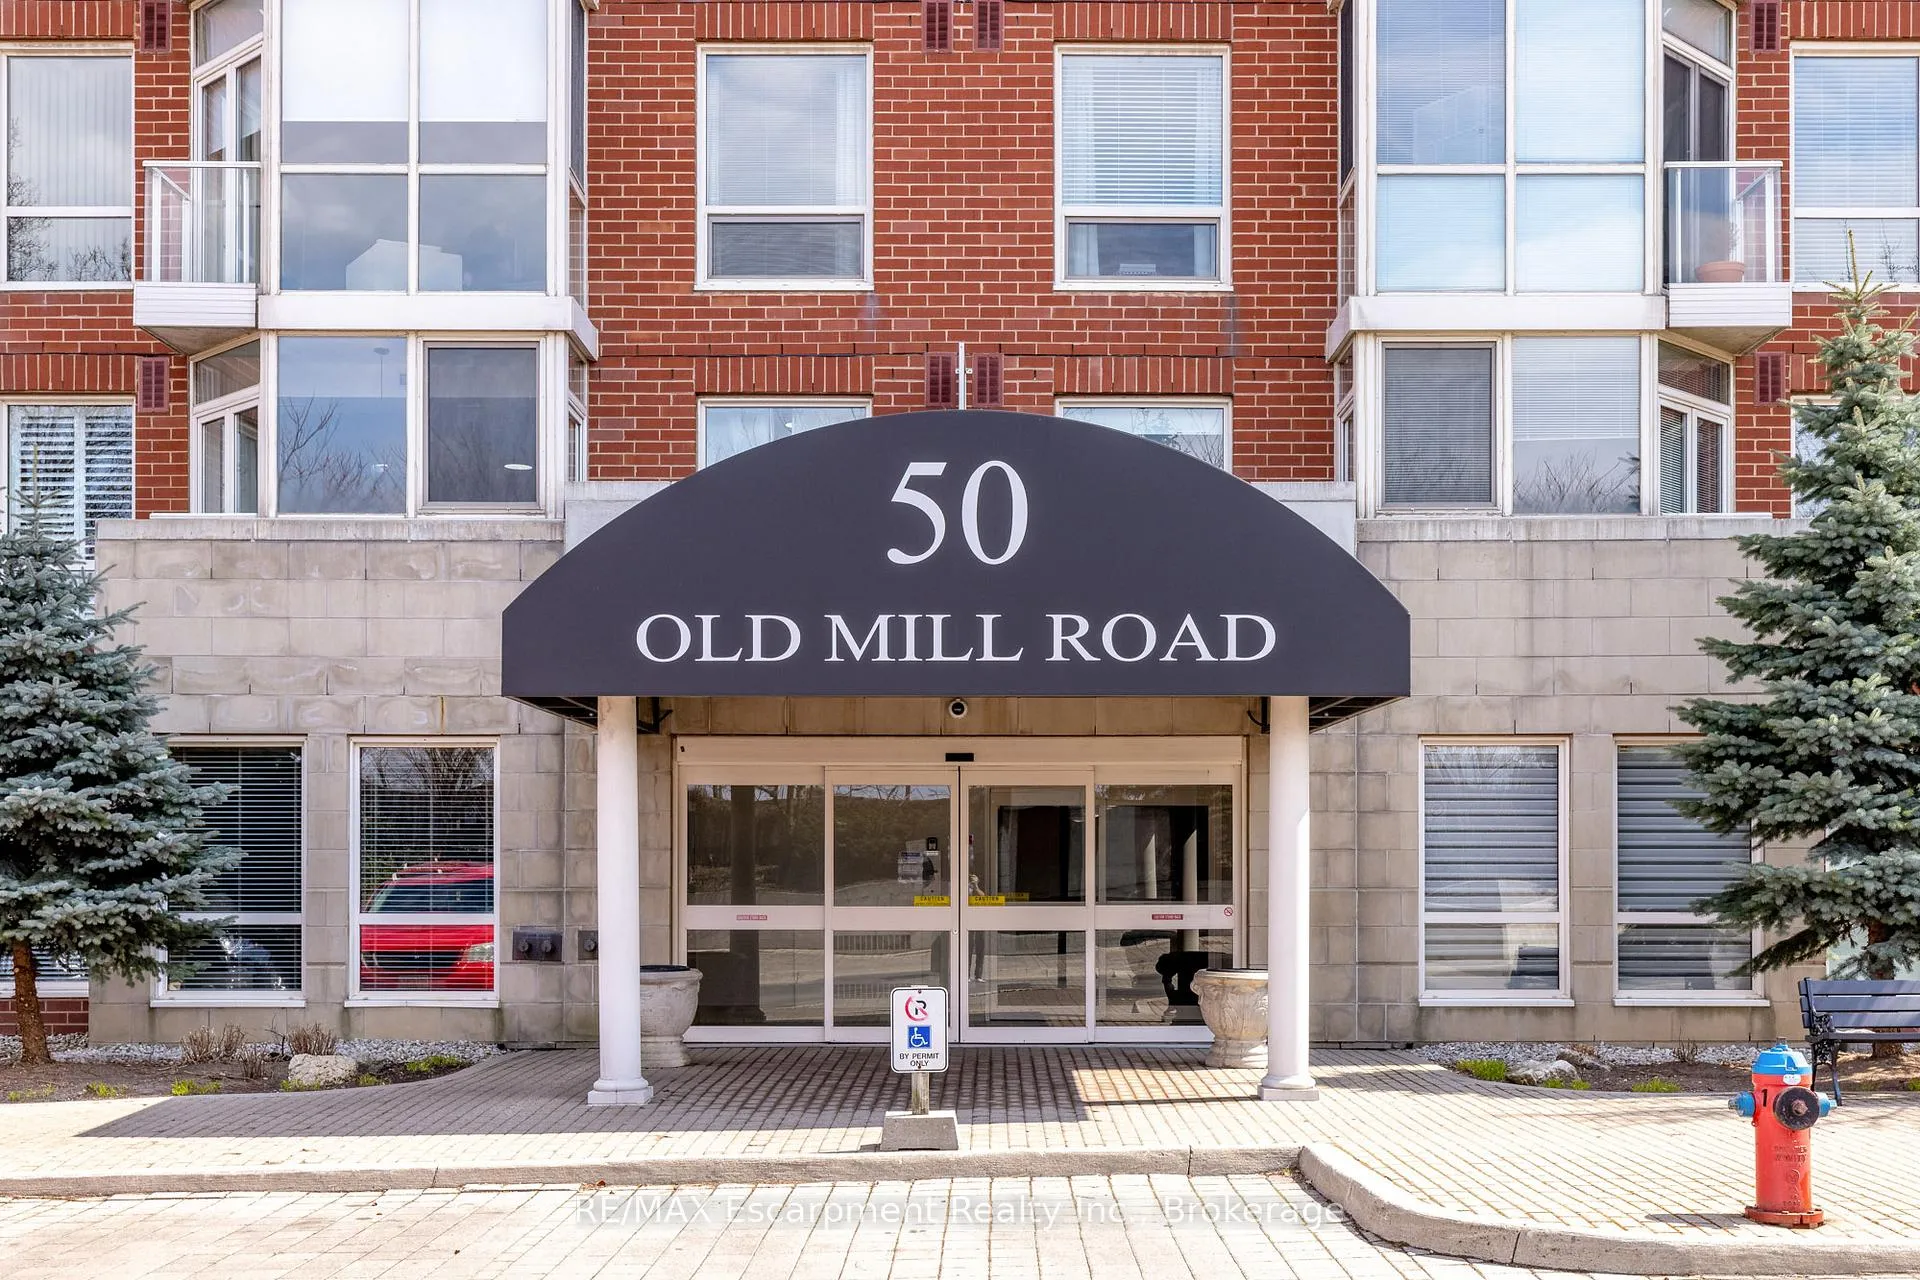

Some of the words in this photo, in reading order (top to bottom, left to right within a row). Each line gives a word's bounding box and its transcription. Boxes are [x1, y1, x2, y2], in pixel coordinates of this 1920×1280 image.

[887, 461, 1028, 565] 50
[637, 614, 800, 662] OLD
[824, 615, 1023, 661] MILL
[1045, 614, 1276, 662] ROAD
[1761, 1089, 1768, 1107] 1
